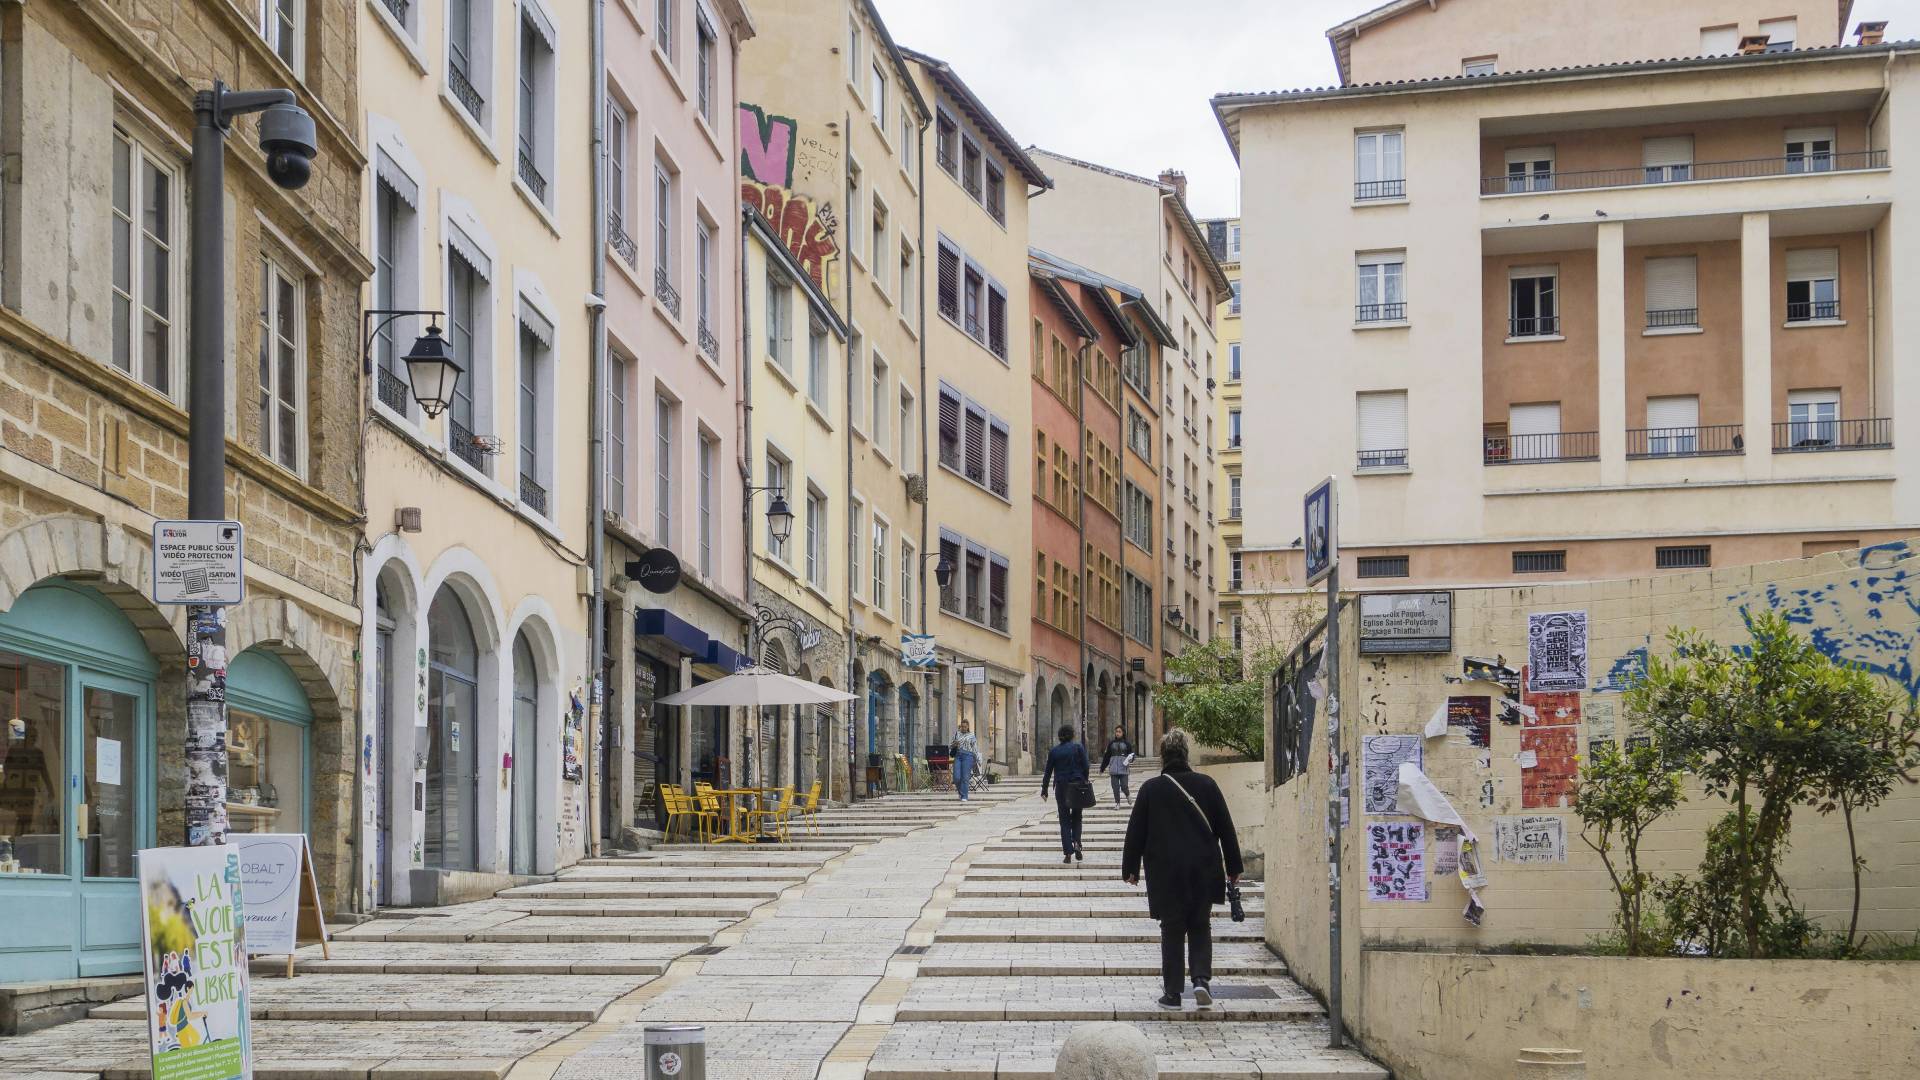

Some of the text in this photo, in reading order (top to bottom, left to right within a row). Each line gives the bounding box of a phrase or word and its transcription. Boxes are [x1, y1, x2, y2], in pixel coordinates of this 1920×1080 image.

[188, 544, 214, 552] PUBLIC
[160, 570, 182, 578] VIDÉO
[1524, 832, 1550, 842] CIA
[241, 863, 285, 875] OBALT
[197, 872, 223, 902] LA
[193, 905, 233, 936] VOIE
[244, 913, 278, 922] venue
[196, 938, 234, 971] EST
[193, 972, 237, 1007] LIBRE
